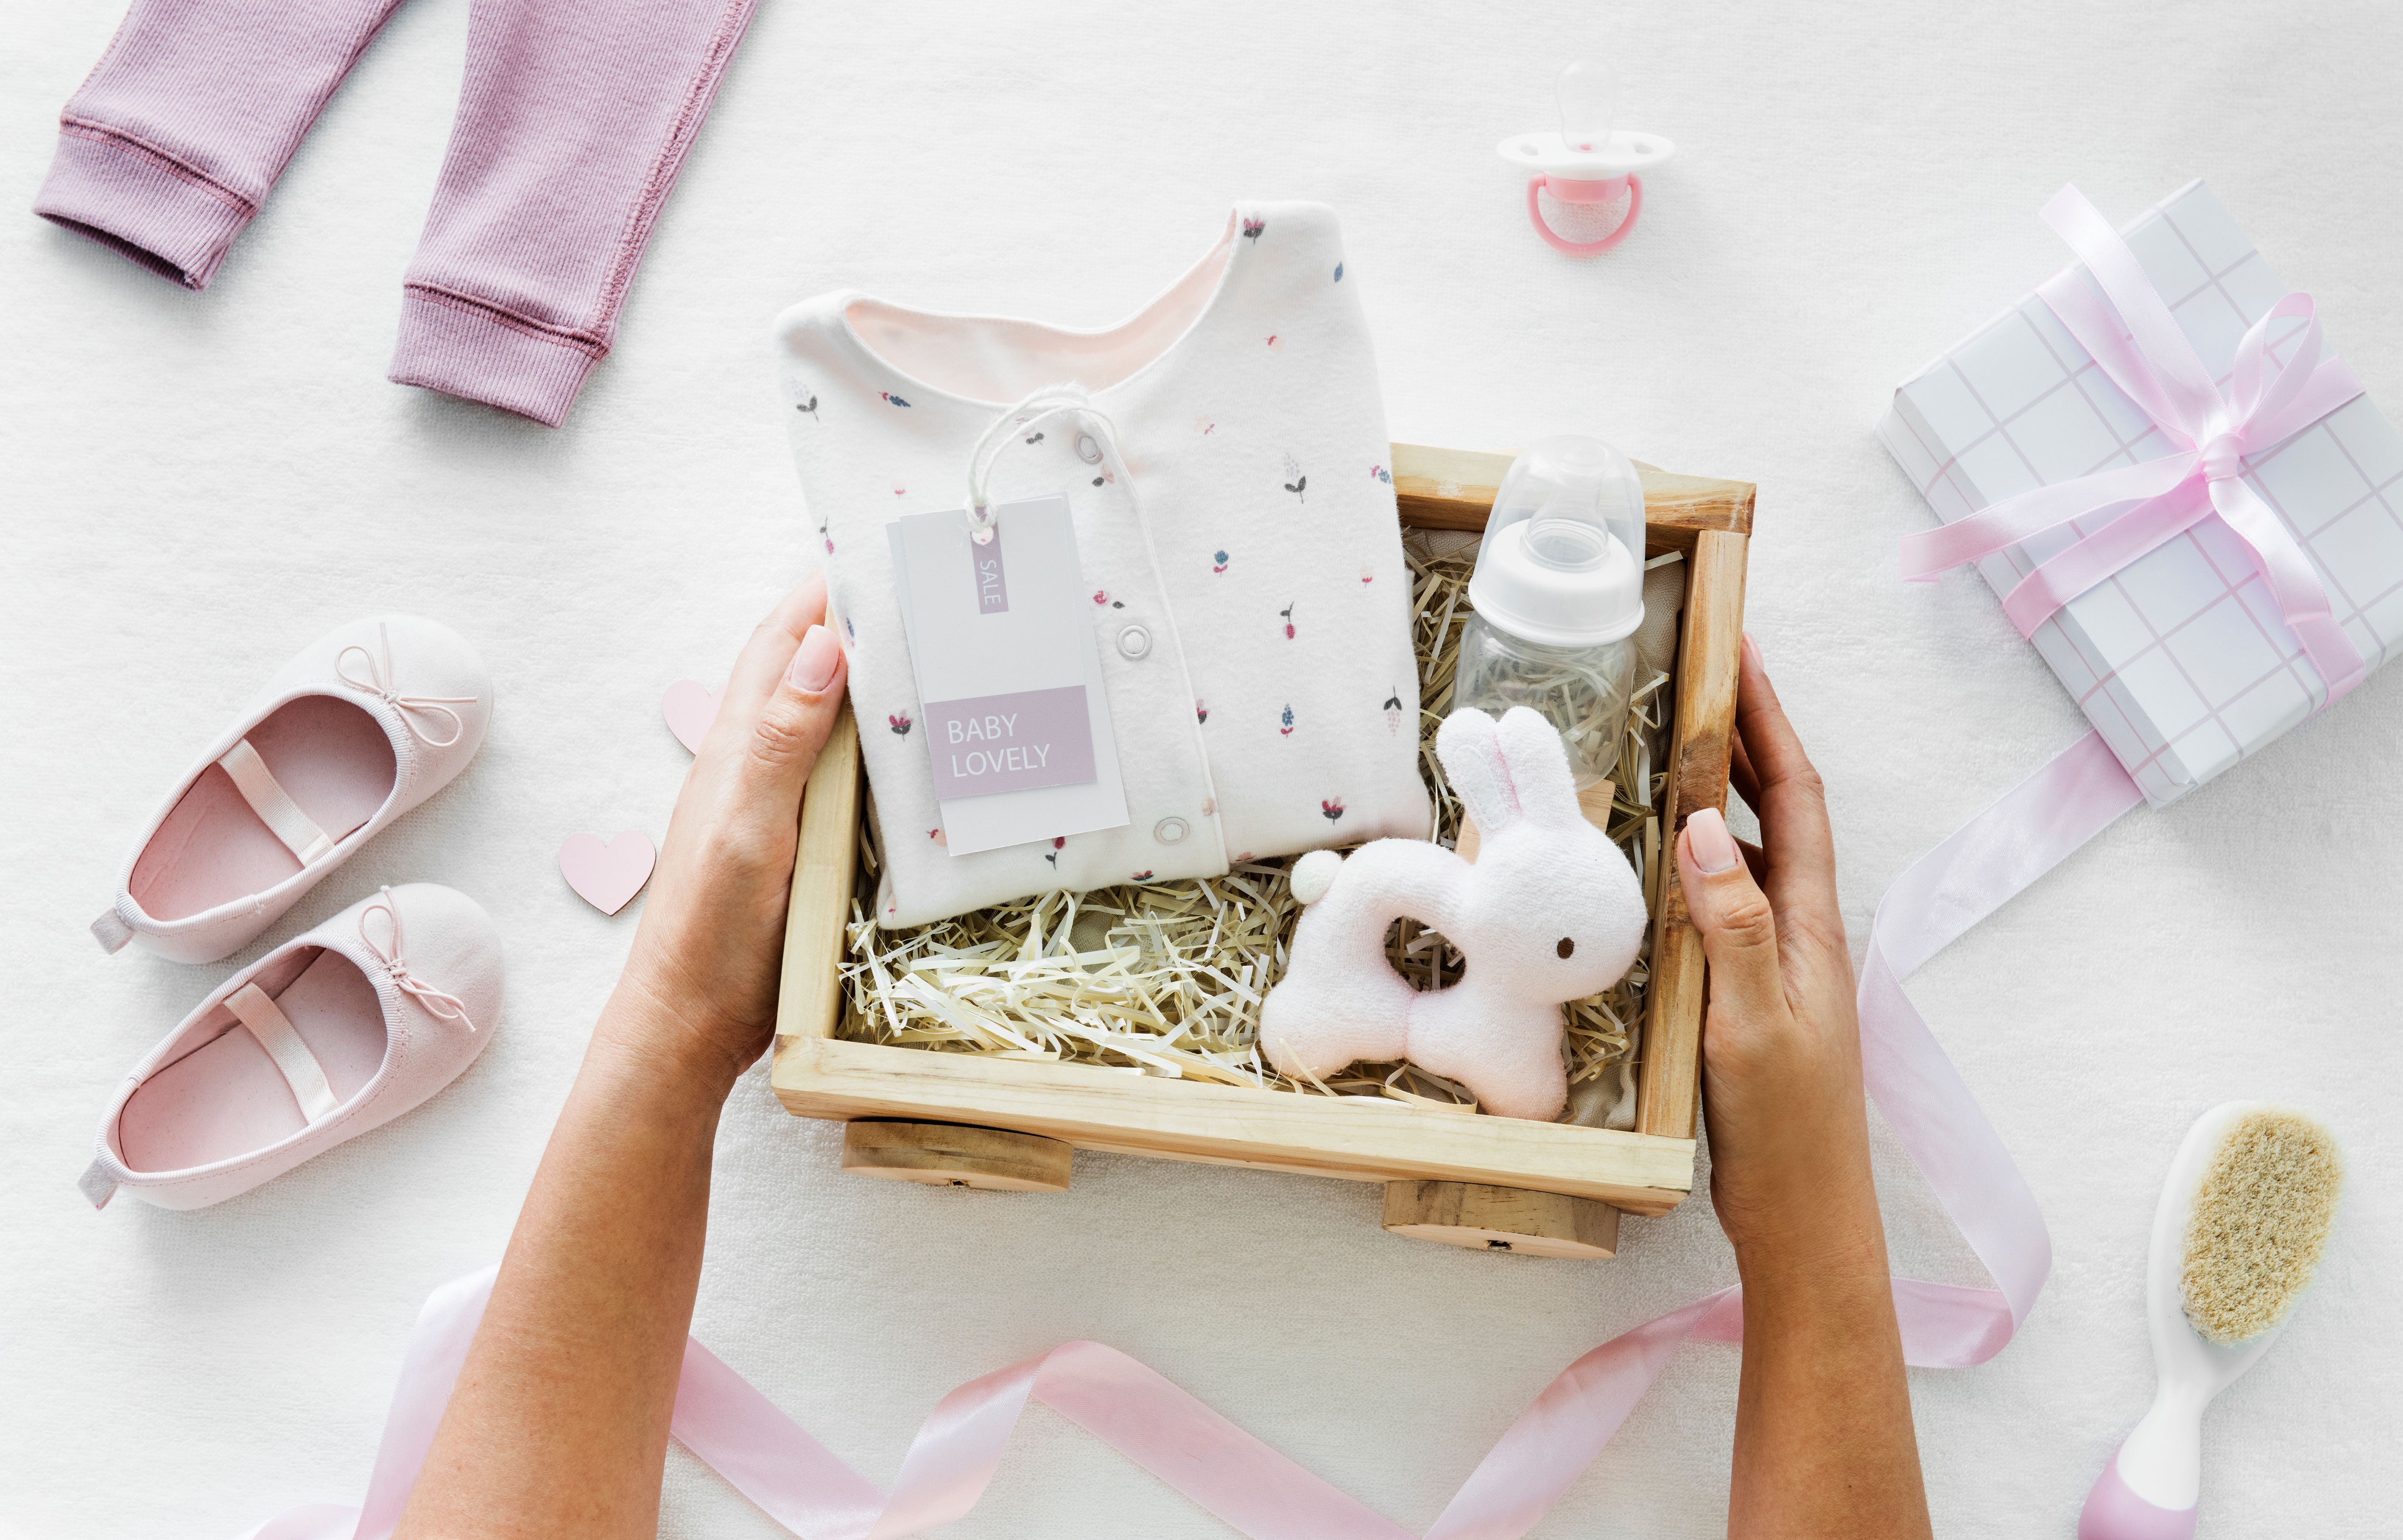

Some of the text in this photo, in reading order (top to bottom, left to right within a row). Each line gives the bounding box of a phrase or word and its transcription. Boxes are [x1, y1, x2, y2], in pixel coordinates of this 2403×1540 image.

[980, 560, 1001, 605] SALE
[948, 713, 1017, 744] BABY
[952, 743, 1050, 777] LOVELY
